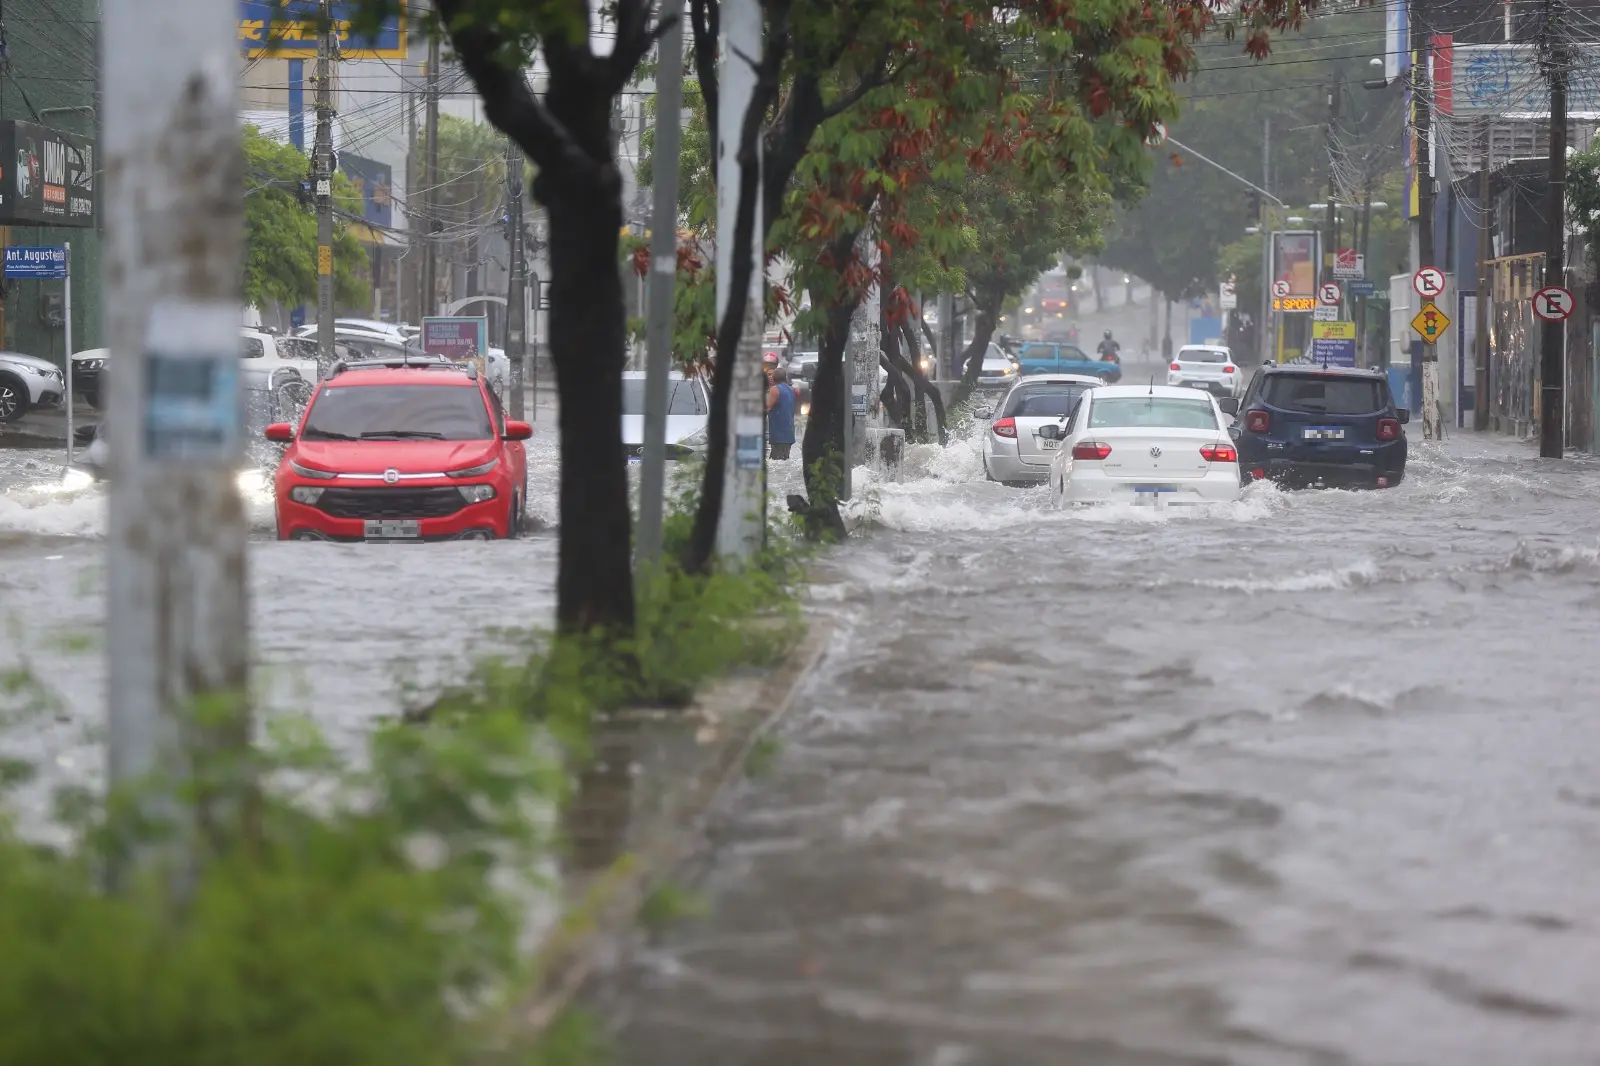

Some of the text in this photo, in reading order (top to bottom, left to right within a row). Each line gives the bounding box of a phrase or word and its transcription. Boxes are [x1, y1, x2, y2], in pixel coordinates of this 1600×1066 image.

[43, 136, 66, 186] UNIÃO
[6, 249, 23, 261] Ant.
[1546, 293, 1563, 314] E
